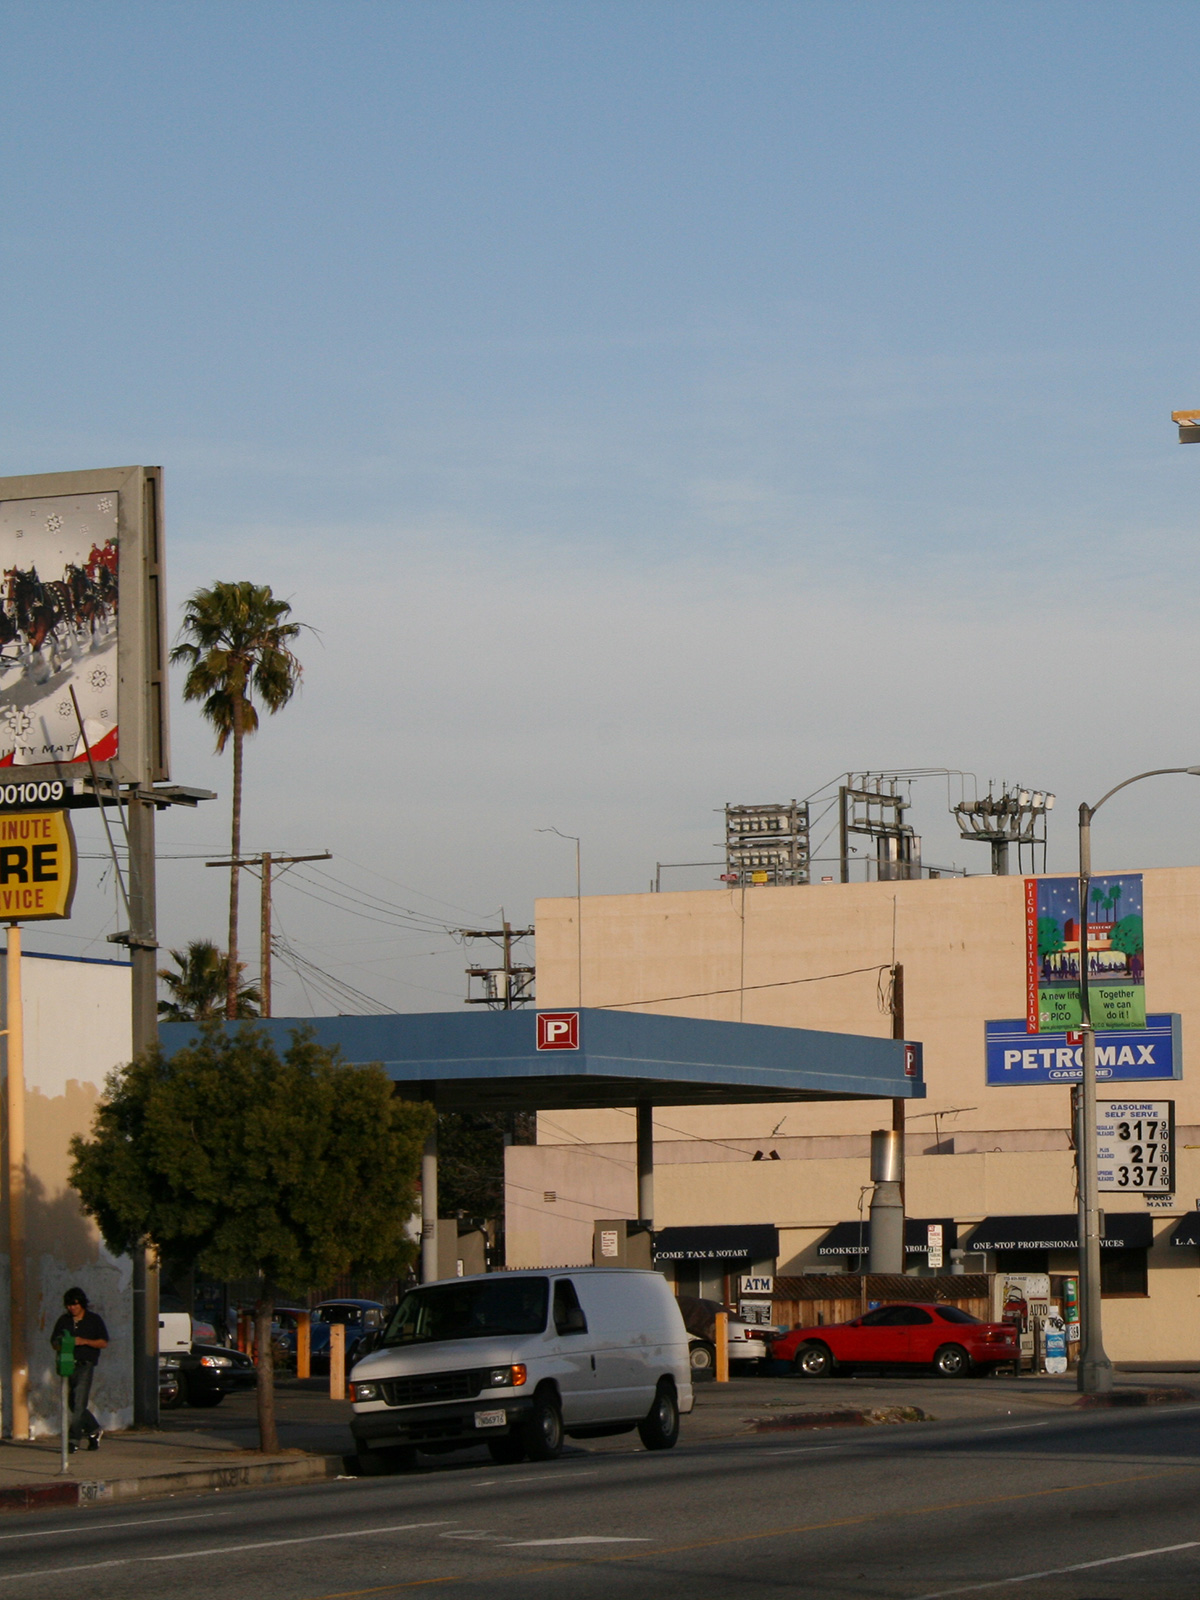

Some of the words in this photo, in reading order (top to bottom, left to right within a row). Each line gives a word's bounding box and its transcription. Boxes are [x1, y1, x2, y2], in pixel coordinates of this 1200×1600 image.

[42, 745, 74, 753] MAT
[0, 781, 64, 804] 01009
[0, 844, 58, 884] RE
[1, 889, 44, 909] VICE
[1027, 919, 1036, 1031] REVITALIZATION
[1068, 992, 1080, 1000] life
[1099, 990, 1135, 1000] Together
[1055, 1002, 1066, 1010] for
[1051, 1012, 1071, 1020] PICO
[1107, 1010, 1117, 1019] do
[547, 1021, 569, 1042] P
[1053, 1070, 1109, 1078] GASONE
[1118, 1121, 1158, 1140] 317
[1118, 1166, 1157, 1186] 337
[716, 1249, 748, 1257] NOTARY
[820, 1246, 870, 1255] BOOKKEEP
[744, 1279, 771, 1290] ATM
[1030, 1304, 1047, 1315] AUTO
